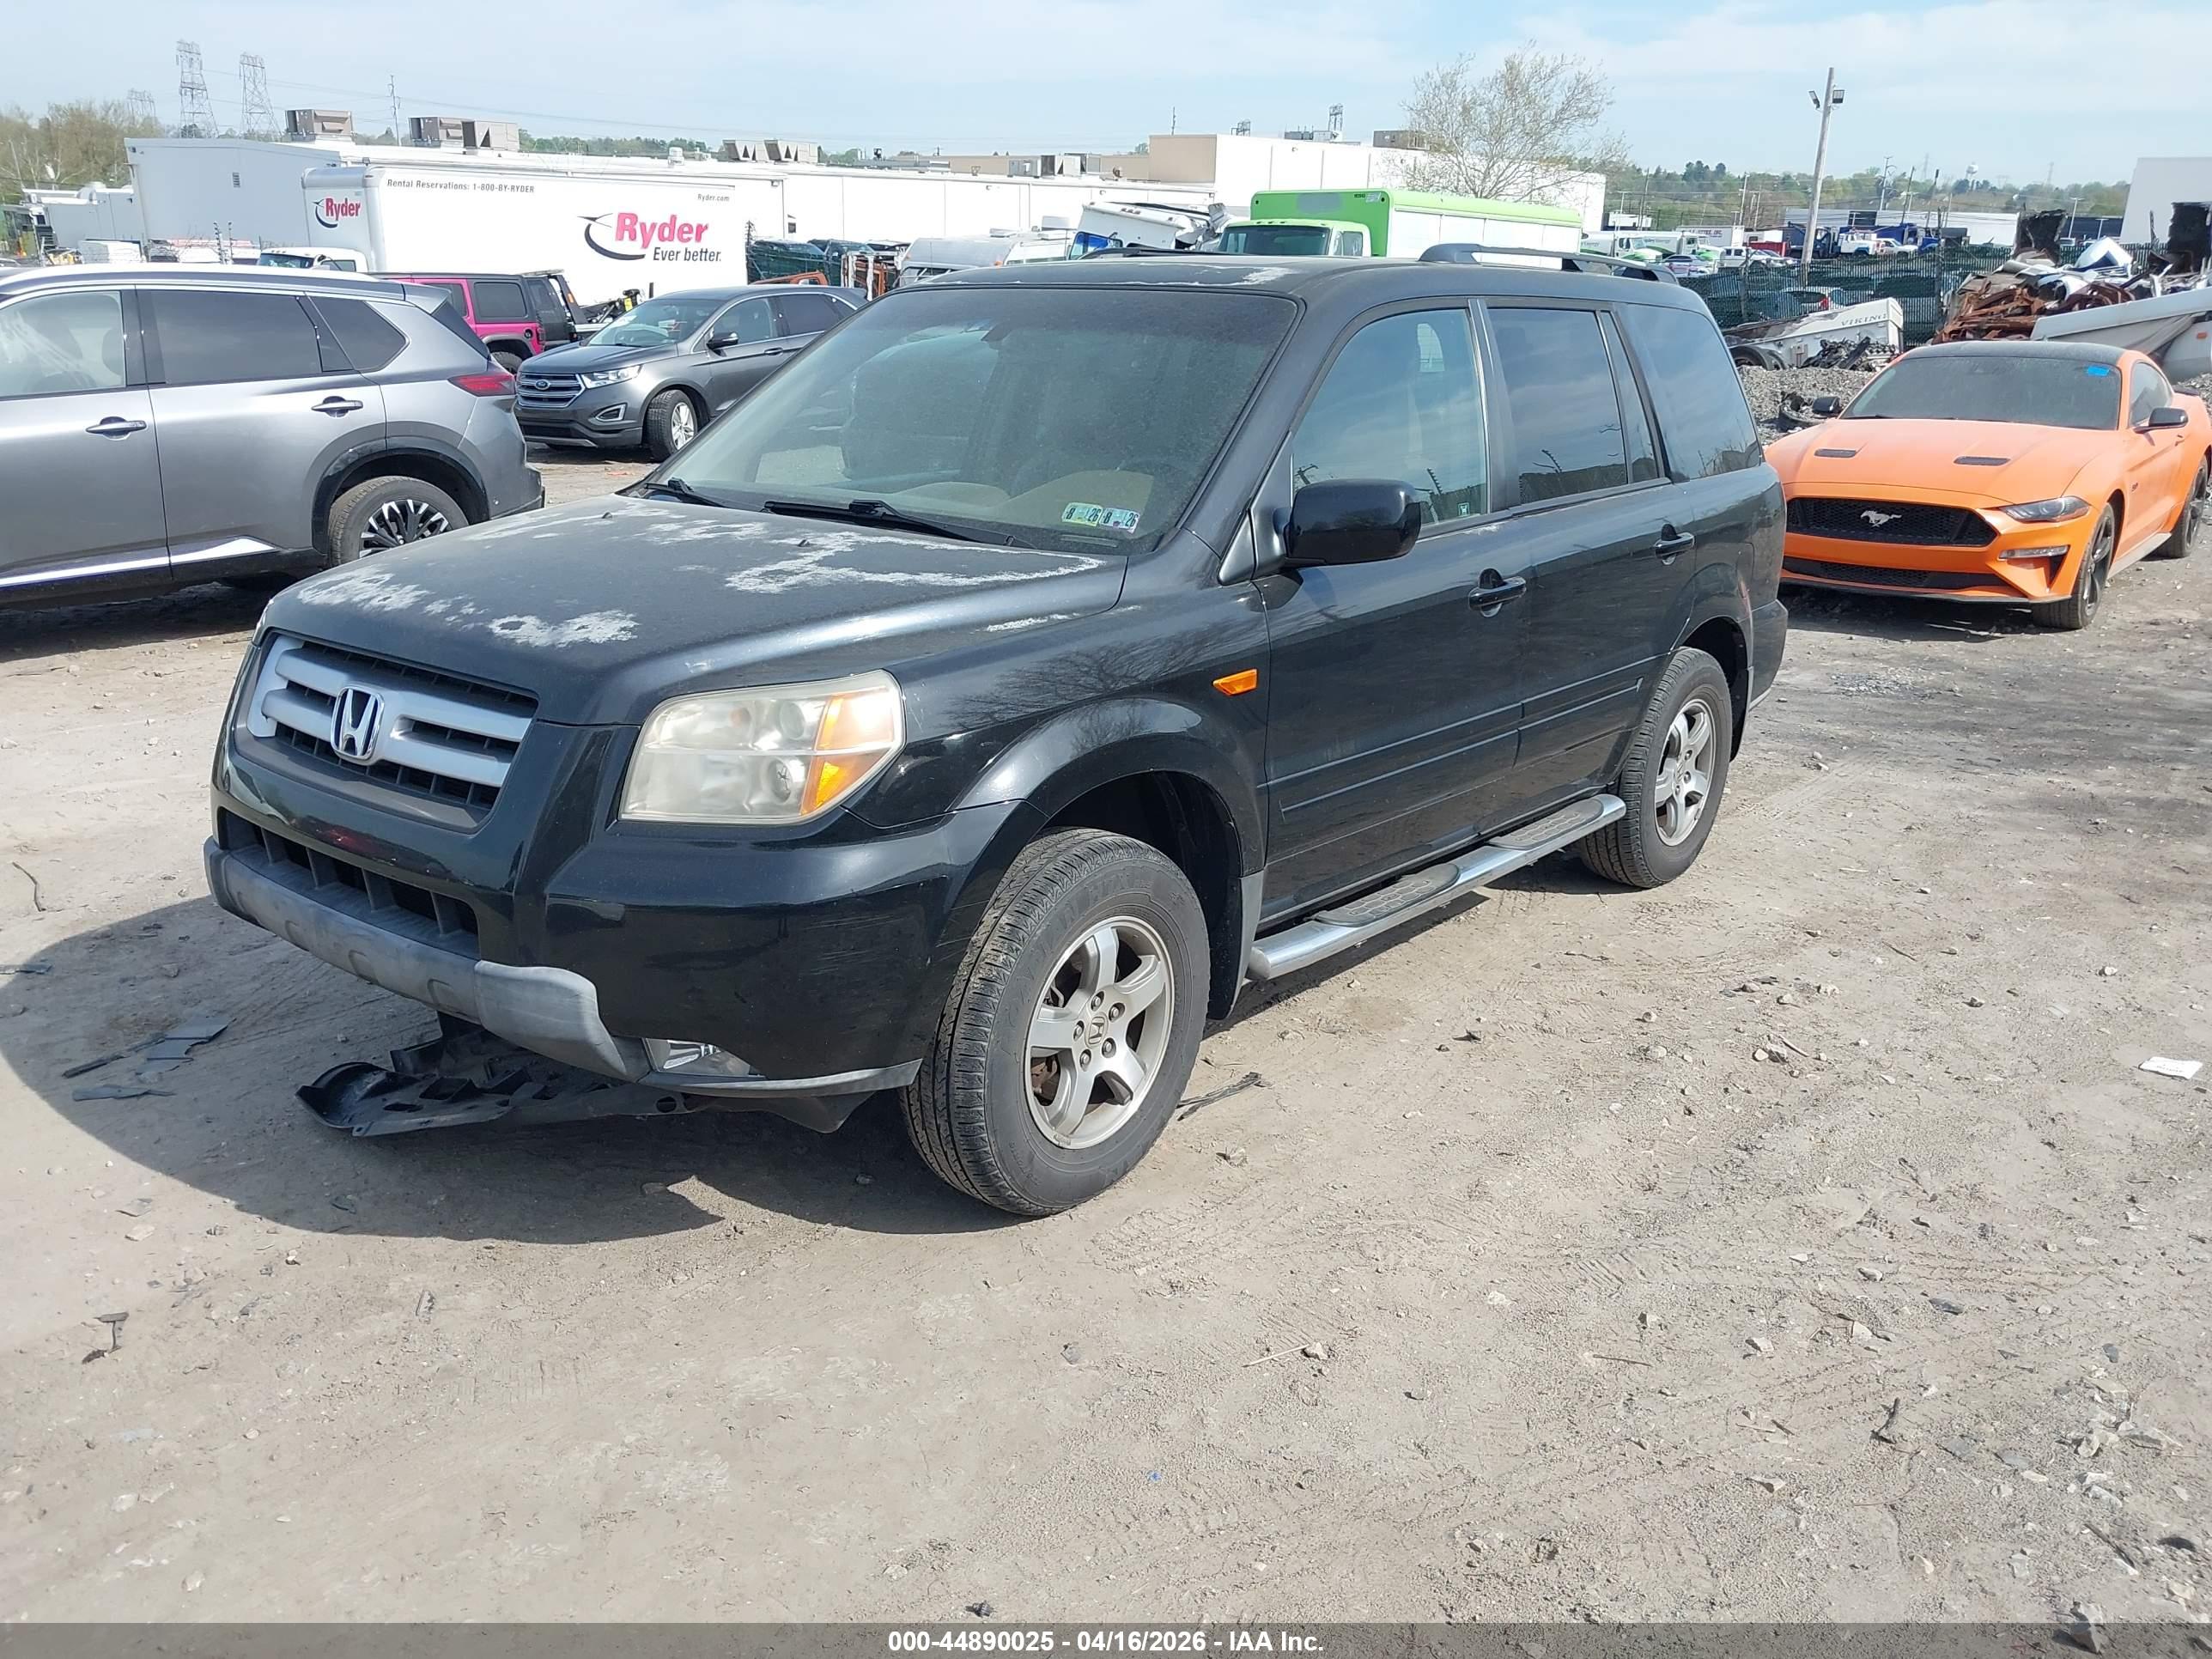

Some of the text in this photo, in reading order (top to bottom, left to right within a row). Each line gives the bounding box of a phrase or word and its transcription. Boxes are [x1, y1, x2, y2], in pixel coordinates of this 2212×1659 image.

[387, 179, 535, 193] Rental Reservations: 1-800-BY-RYDER
[697, 193, 730, 203] Ryder.com
[325, 198, 362, 222] Ryder
[616, 212, 708, 249] Ryder
[653, 246, 722, 262] Ever better.
[1841, 313, 1887, 326] VIKING
